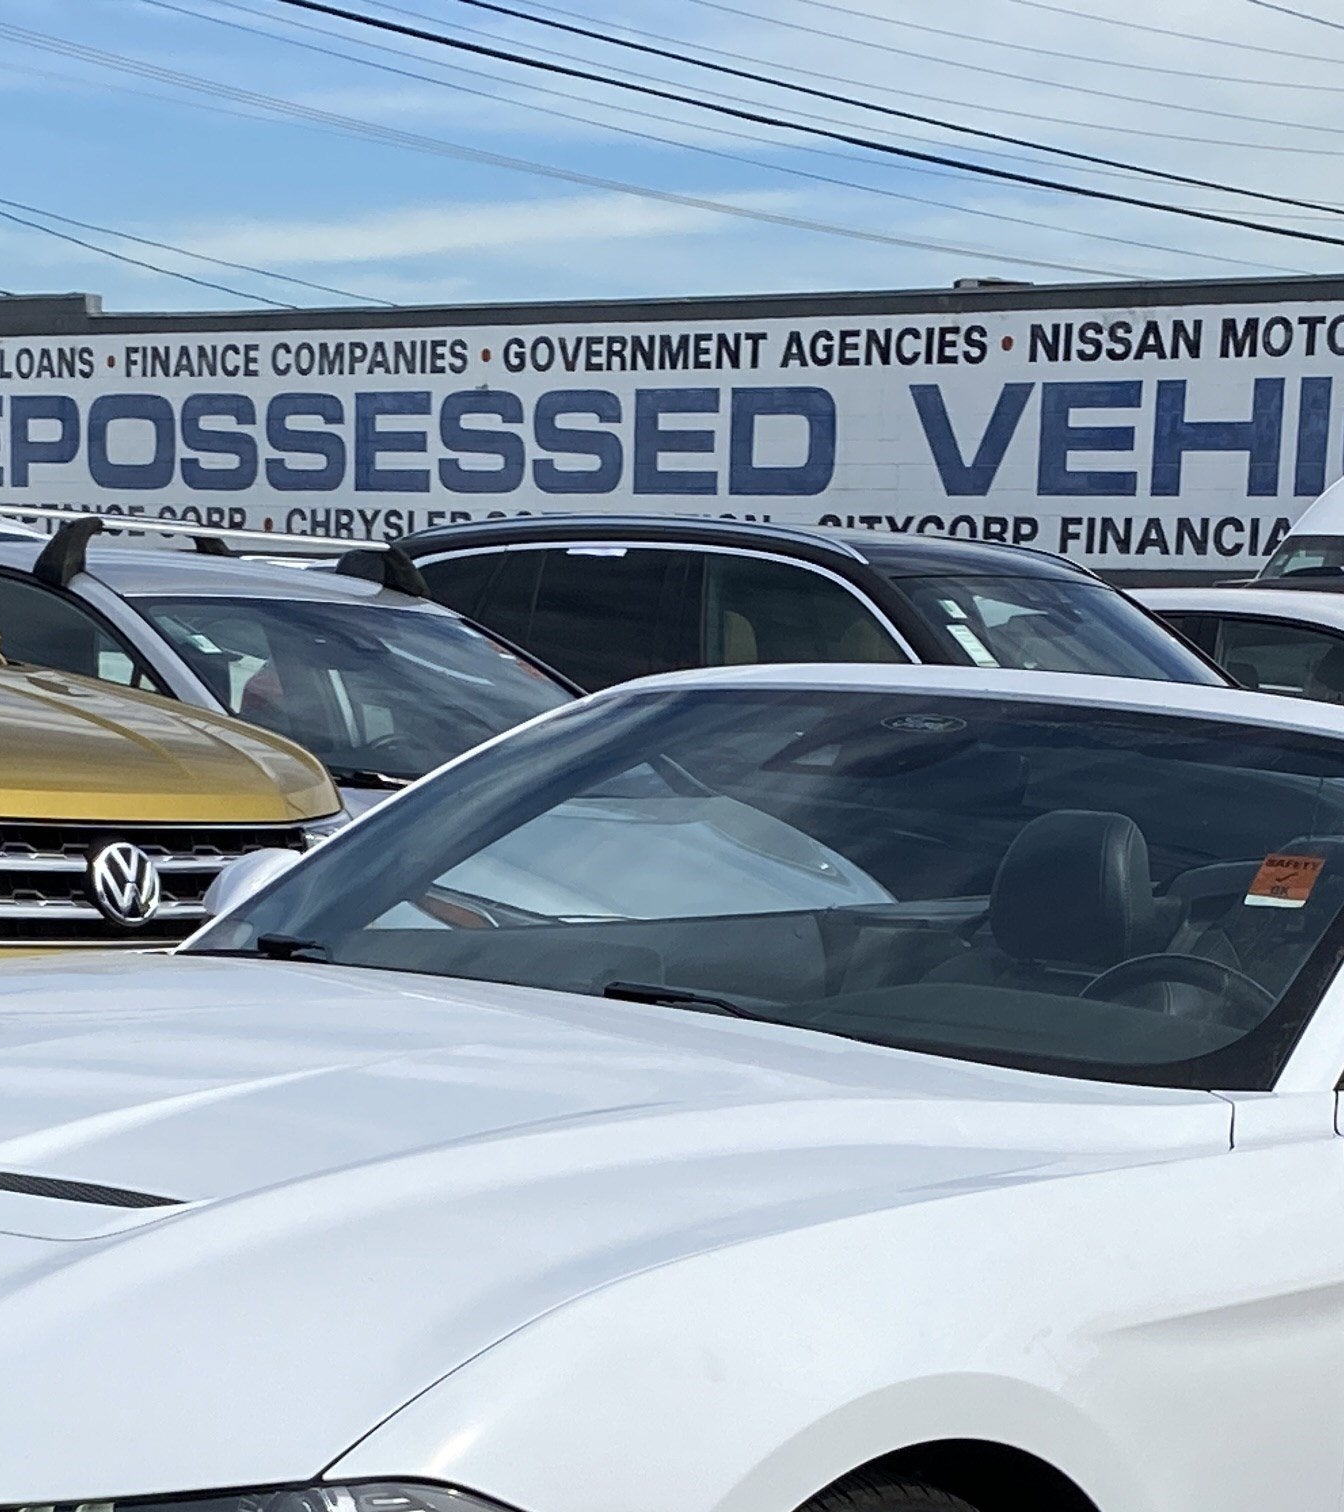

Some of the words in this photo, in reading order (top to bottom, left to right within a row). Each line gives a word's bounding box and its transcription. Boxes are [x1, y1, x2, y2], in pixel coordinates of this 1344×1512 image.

[124, 343, 260, 378] FINANCE
[271, 338, 468, 376] COMPANIES
[502, 331, 768, 374] GOVERNMENT
[779, 325, 988, 369] AGENCIES
[1028, 319, 1203, 363] NISSAN
[286, 507, 472, 541] CHRYSL
